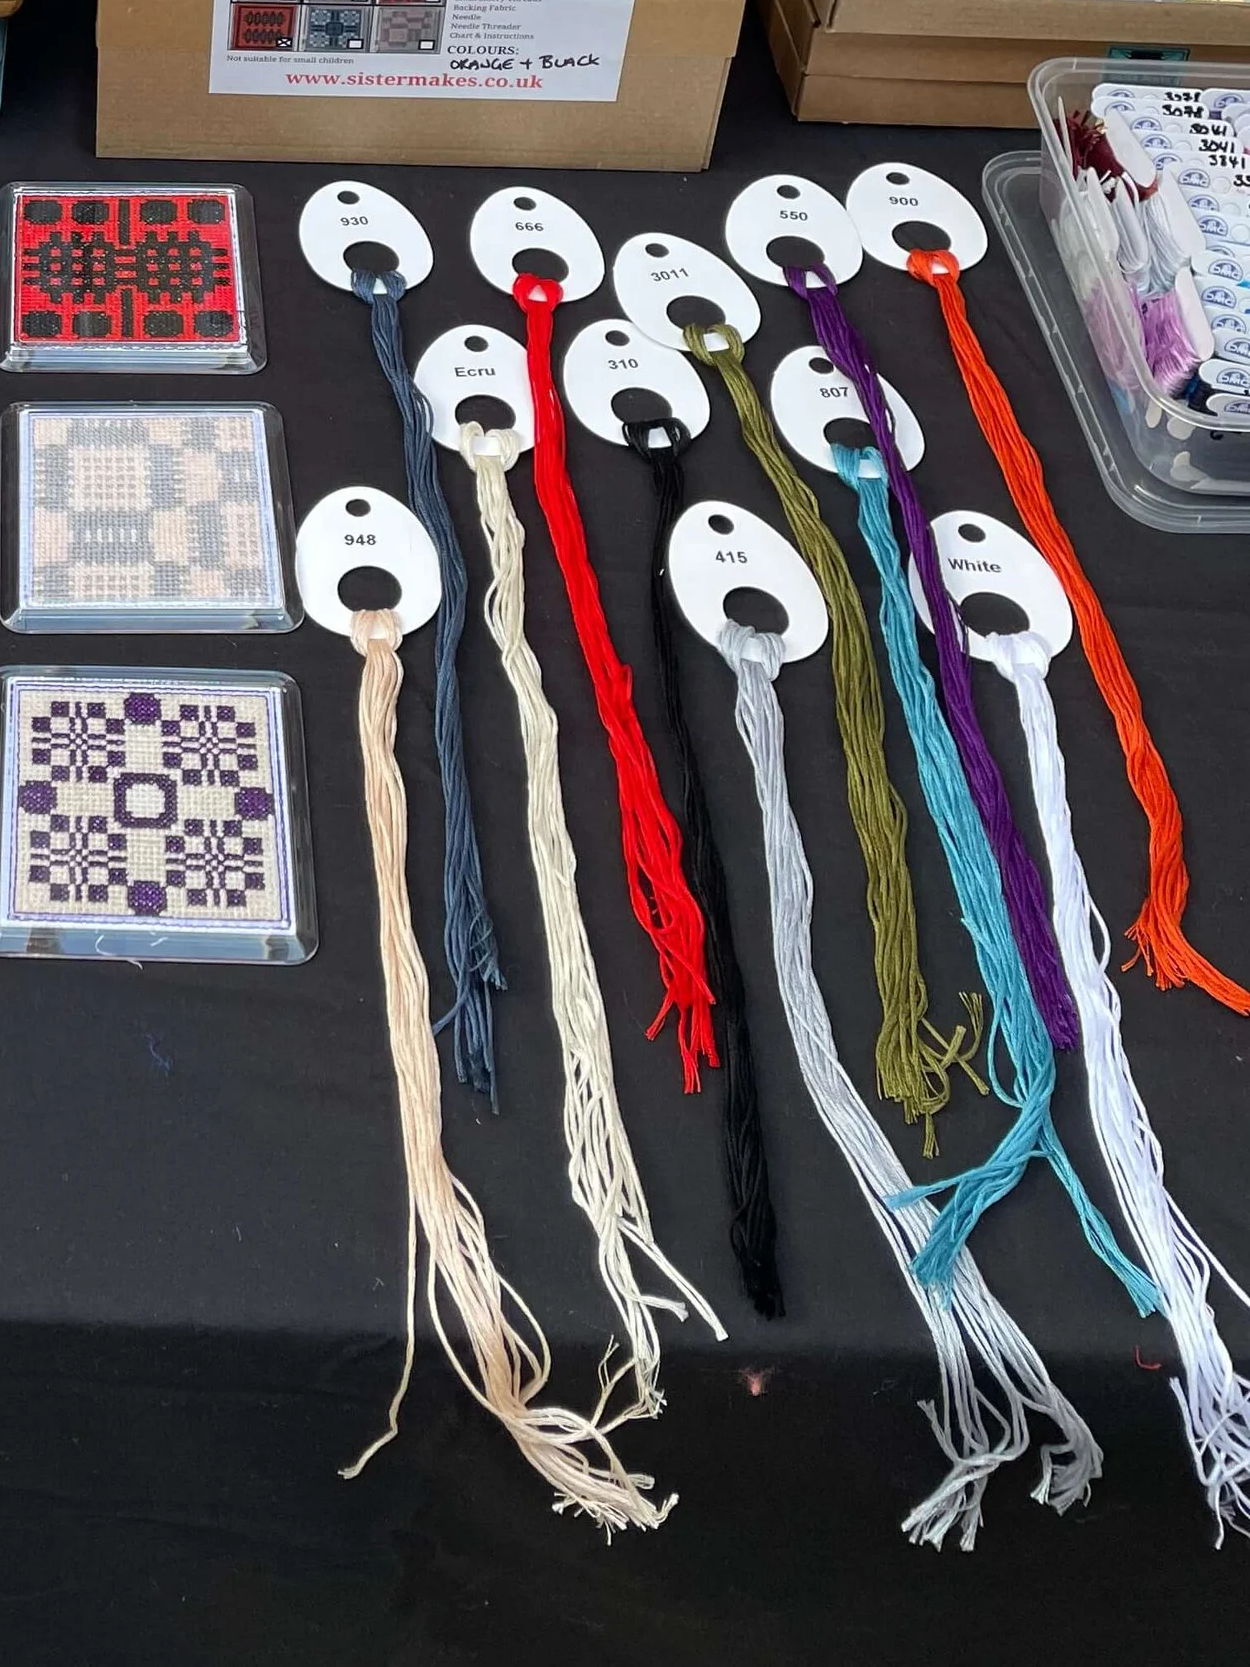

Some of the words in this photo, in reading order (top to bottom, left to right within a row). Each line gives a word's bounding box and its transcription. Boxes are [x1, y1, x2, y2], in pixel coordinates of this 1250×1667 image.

[447, 46, 519, 55] COLOURS:
[451, 58, 514, 70] ORANGE
[520, 59, 532, 70] +
[286, 72, 543, 89] www.sistermakes.co.uk
[889, 196, 919, 207] 900
[340, 215, 368, 226] 930
[779, 210, 808, 221] 550
[515, 221, 544, 232] 666
[650, 267, 689, 282] 3011
[607, 357, 638, 370] 310
[454, 365, 496, 378] Ecru
[820, 387, 849, 398] 807
[343, 533, 377, 548] 948
[713, 550, 748, 565] 415
[948, 556, 1002, 575] White
